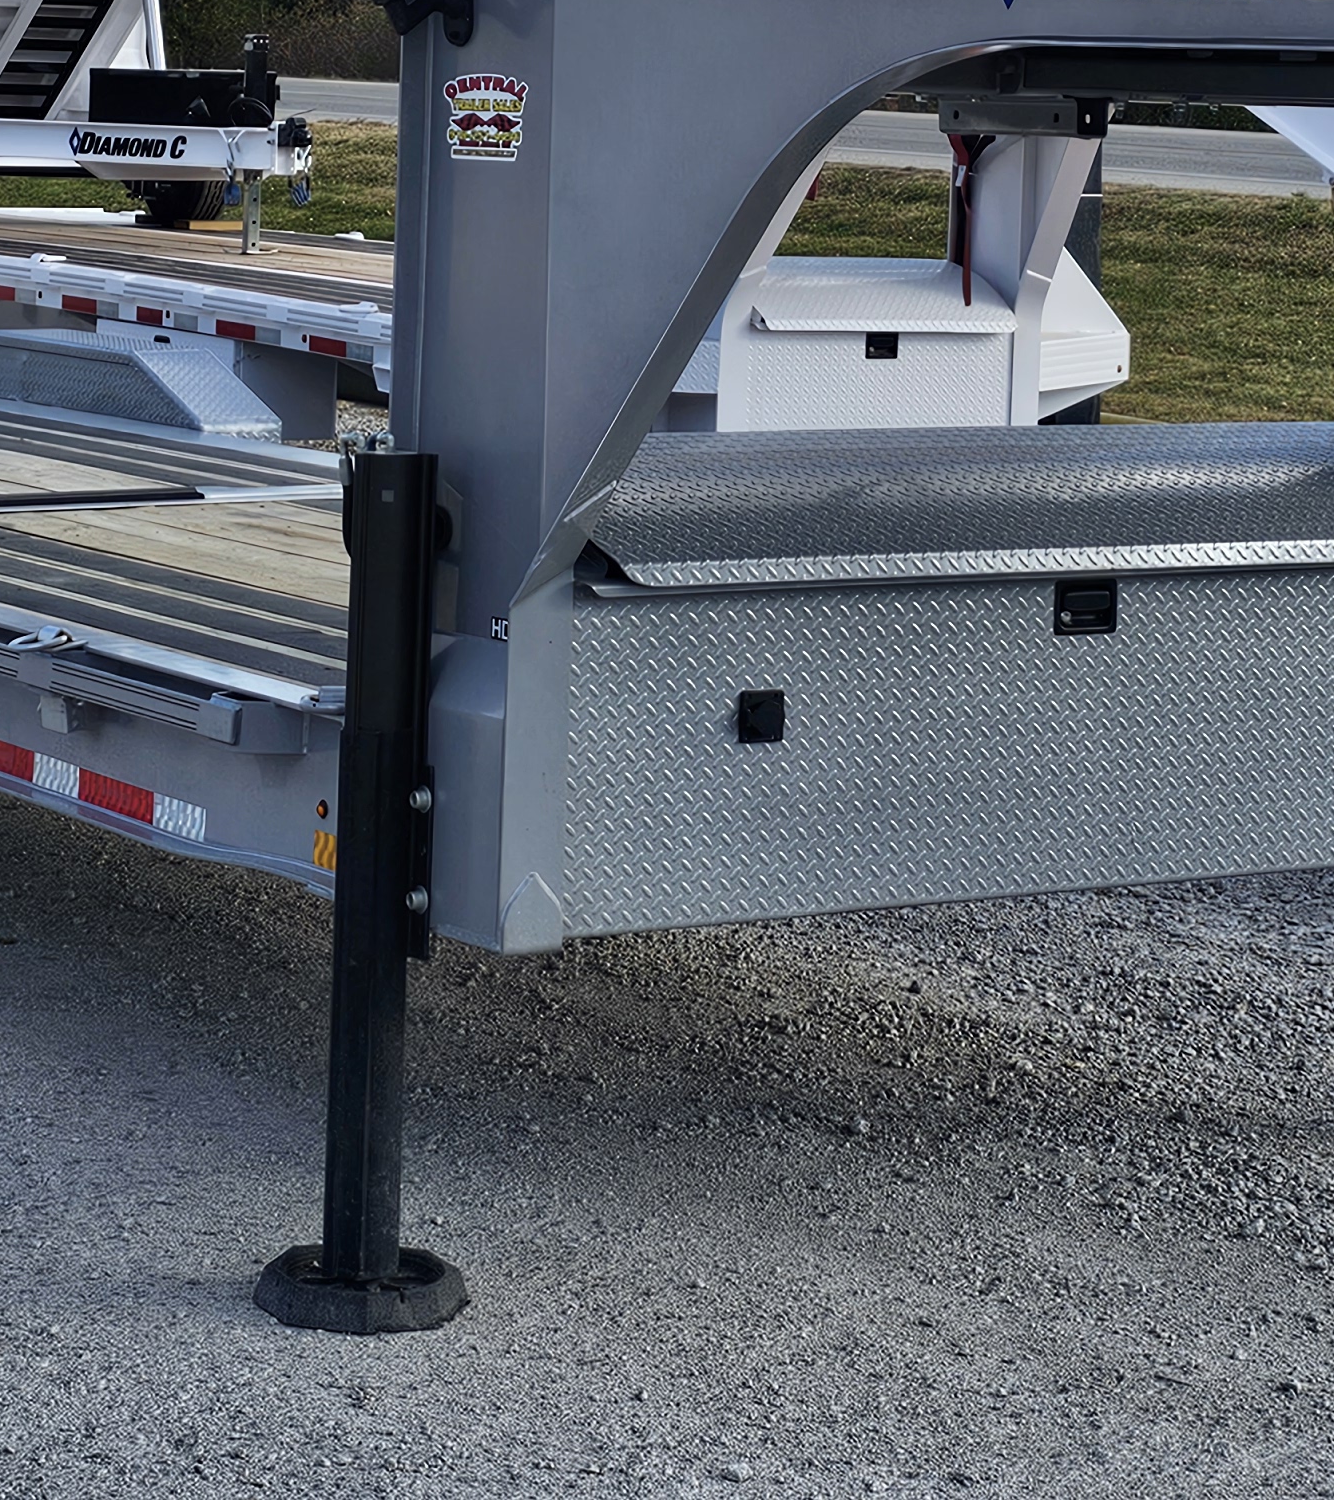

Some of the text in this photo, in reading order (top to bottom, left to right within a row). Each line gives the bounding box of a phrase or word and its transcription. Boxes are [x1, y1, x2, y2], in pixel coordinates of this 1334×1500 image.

[444, 75, 527, 102] CENTRAL
[78, 131, 187, 159] DIAMOND C
